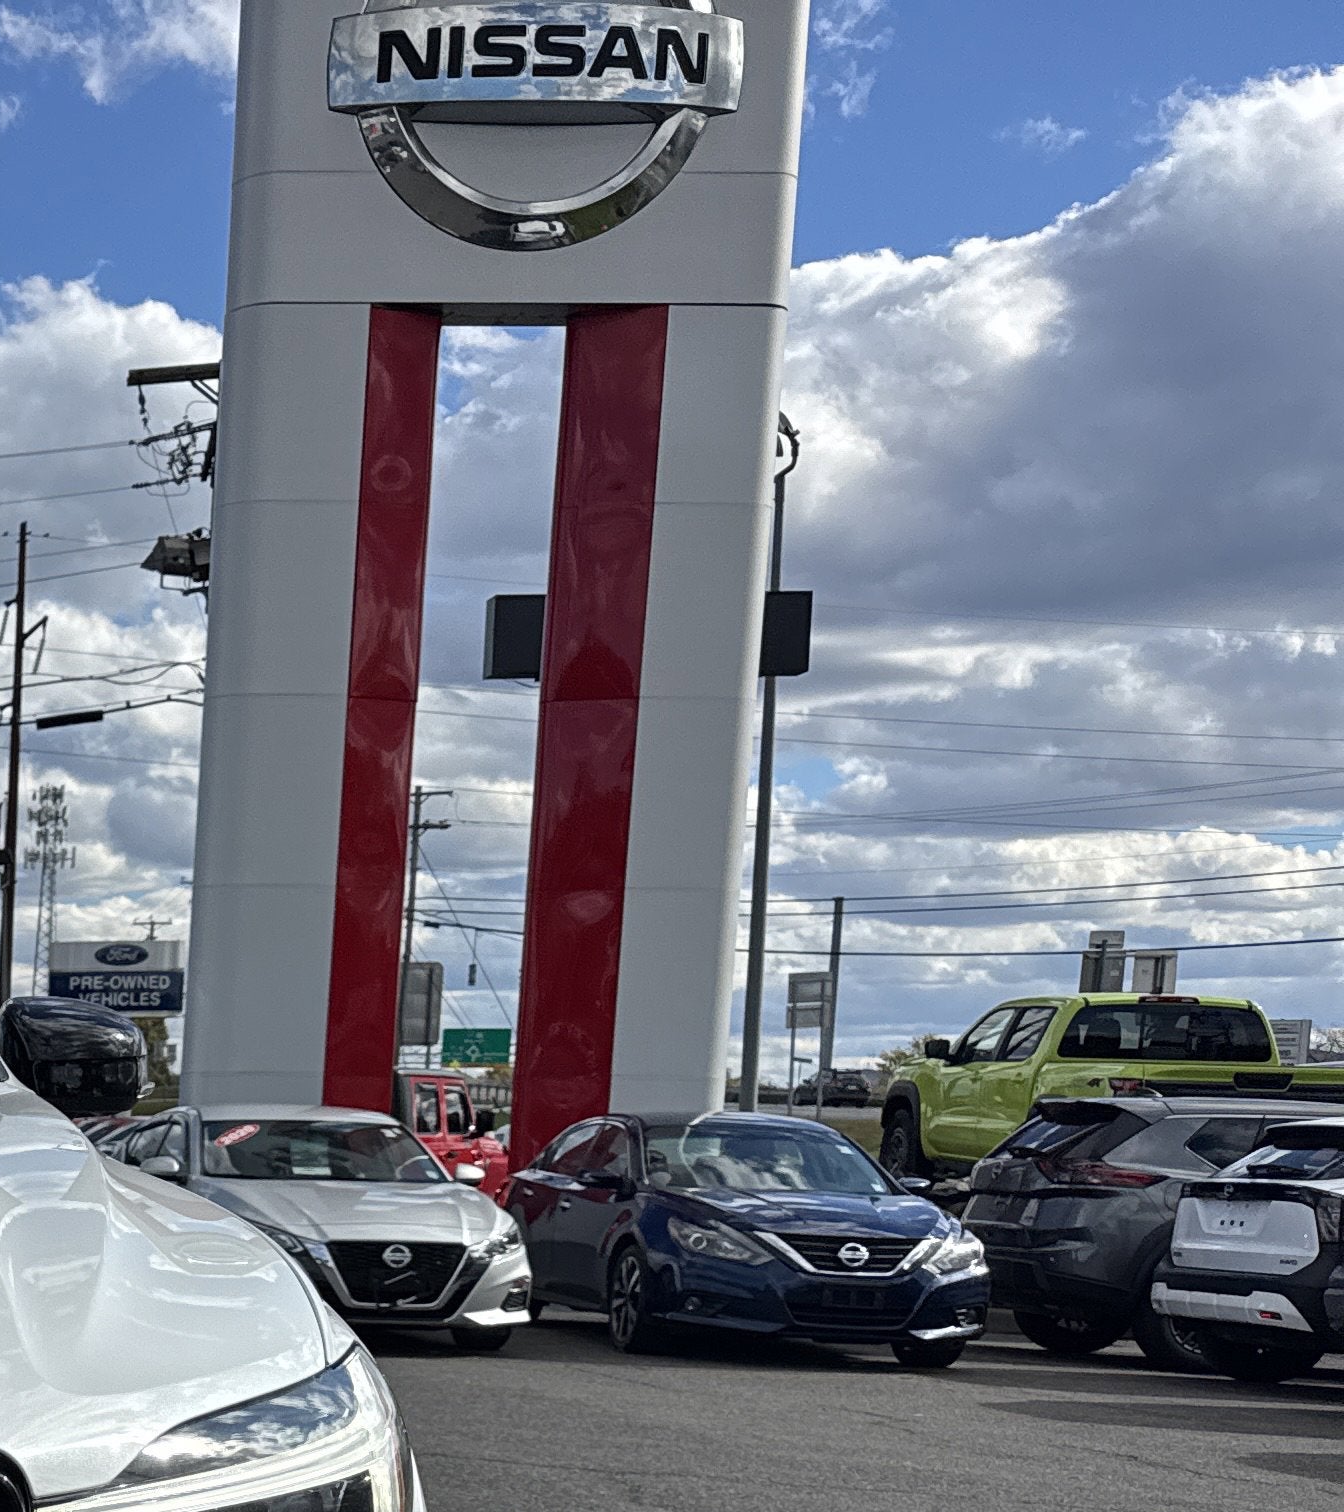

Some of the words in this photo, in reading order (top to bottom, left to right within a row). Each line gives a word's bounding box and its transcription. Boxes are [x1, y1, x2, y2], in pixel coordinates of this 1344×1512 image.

[376, 24, 710, 85] NISSAN
[105, 946, 140, 961] Ford
[69, 975, 171, 990] PRE-OWNED
[79, 991, 161, 1007] VEHICLES
